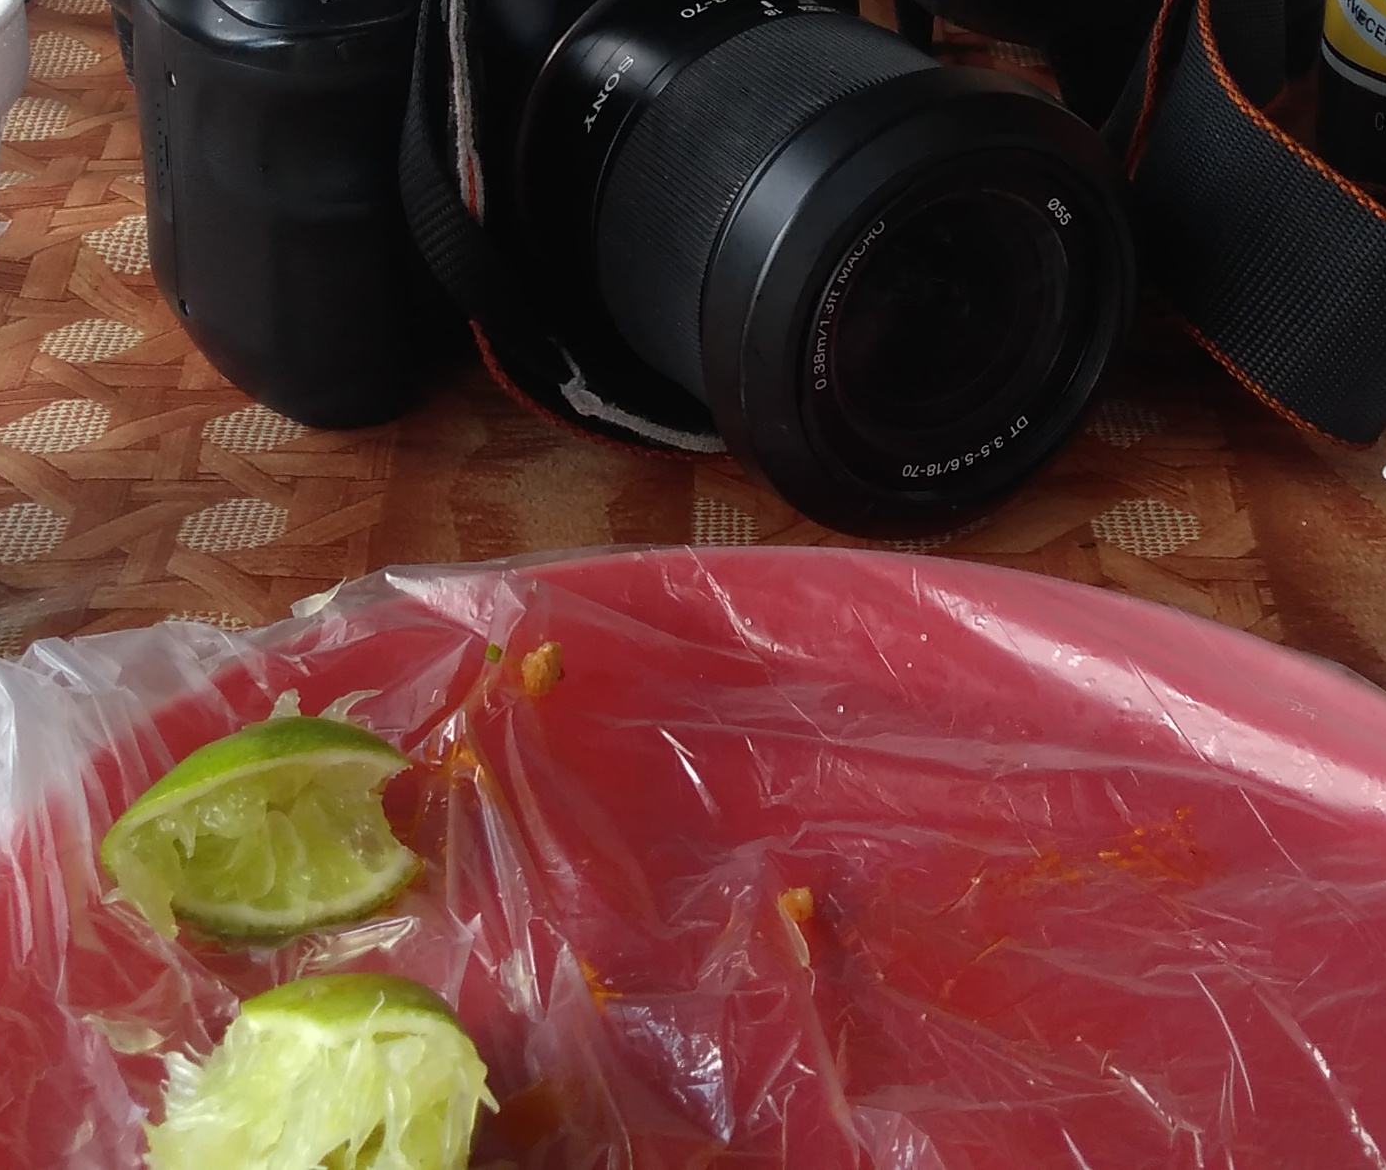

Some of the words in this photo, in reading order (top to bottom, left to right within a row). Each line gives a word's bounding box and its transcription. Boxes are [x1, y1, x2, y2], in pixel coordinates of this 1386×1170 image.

[583, 56, 635, 134] SONY
[1010, 415, 1029, 438] DT
[902, 435, 1004, 478] 3.5-5.6/18-70
